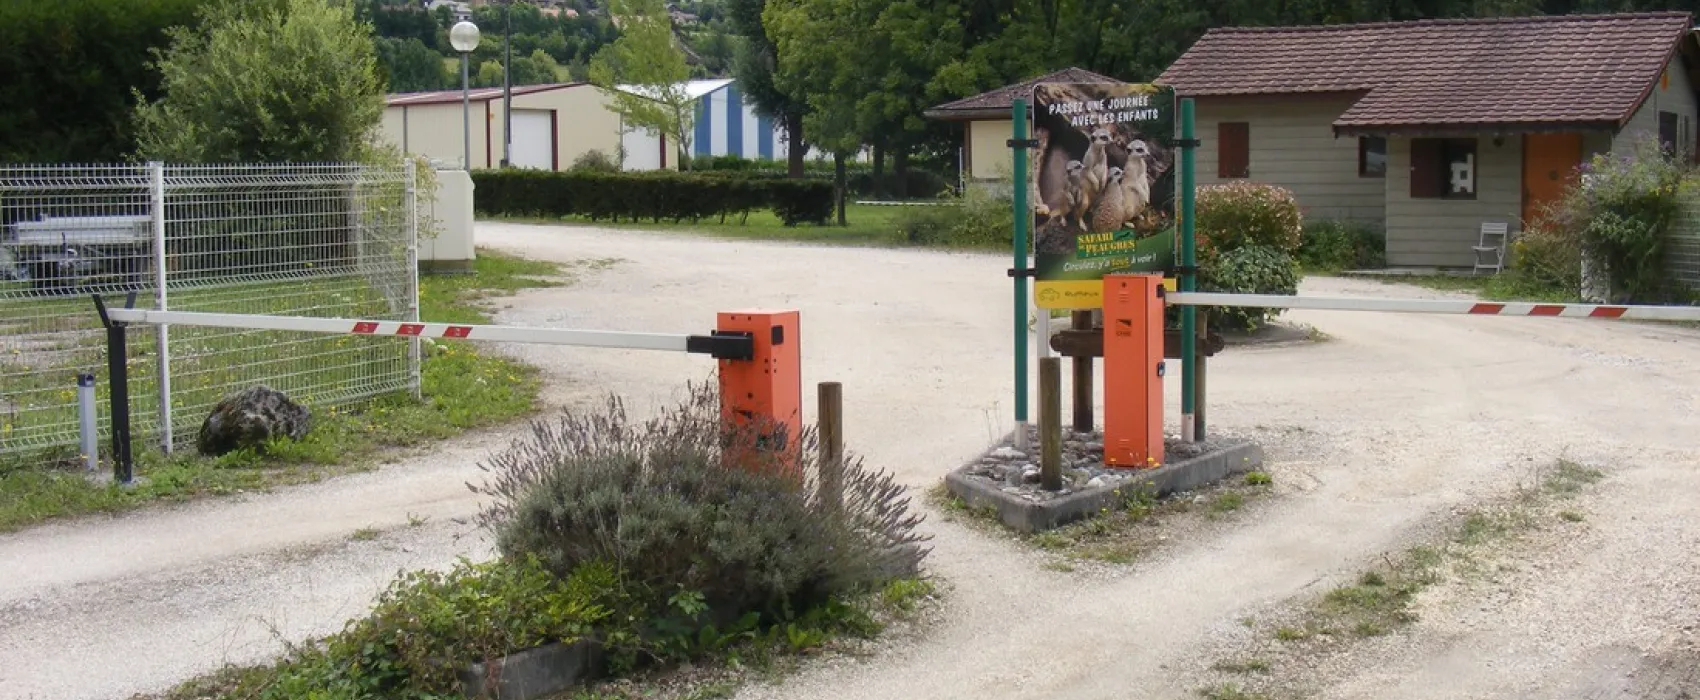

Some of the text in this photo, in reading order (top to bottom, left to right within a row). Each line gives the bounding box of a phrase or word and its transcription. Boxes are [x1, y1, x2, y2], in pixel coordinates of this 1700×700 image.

[1048, 93, 1149, 115] PASSEZ UNE JOURNÉE
[1071, 108, 1158, 127] AVEC LES ENFANTS
[1077, 232, 1113, 243] SAFARI
[1085, 240, 1135, 253] PEAUGRES
[1111, 256, 1129, 267] tout
